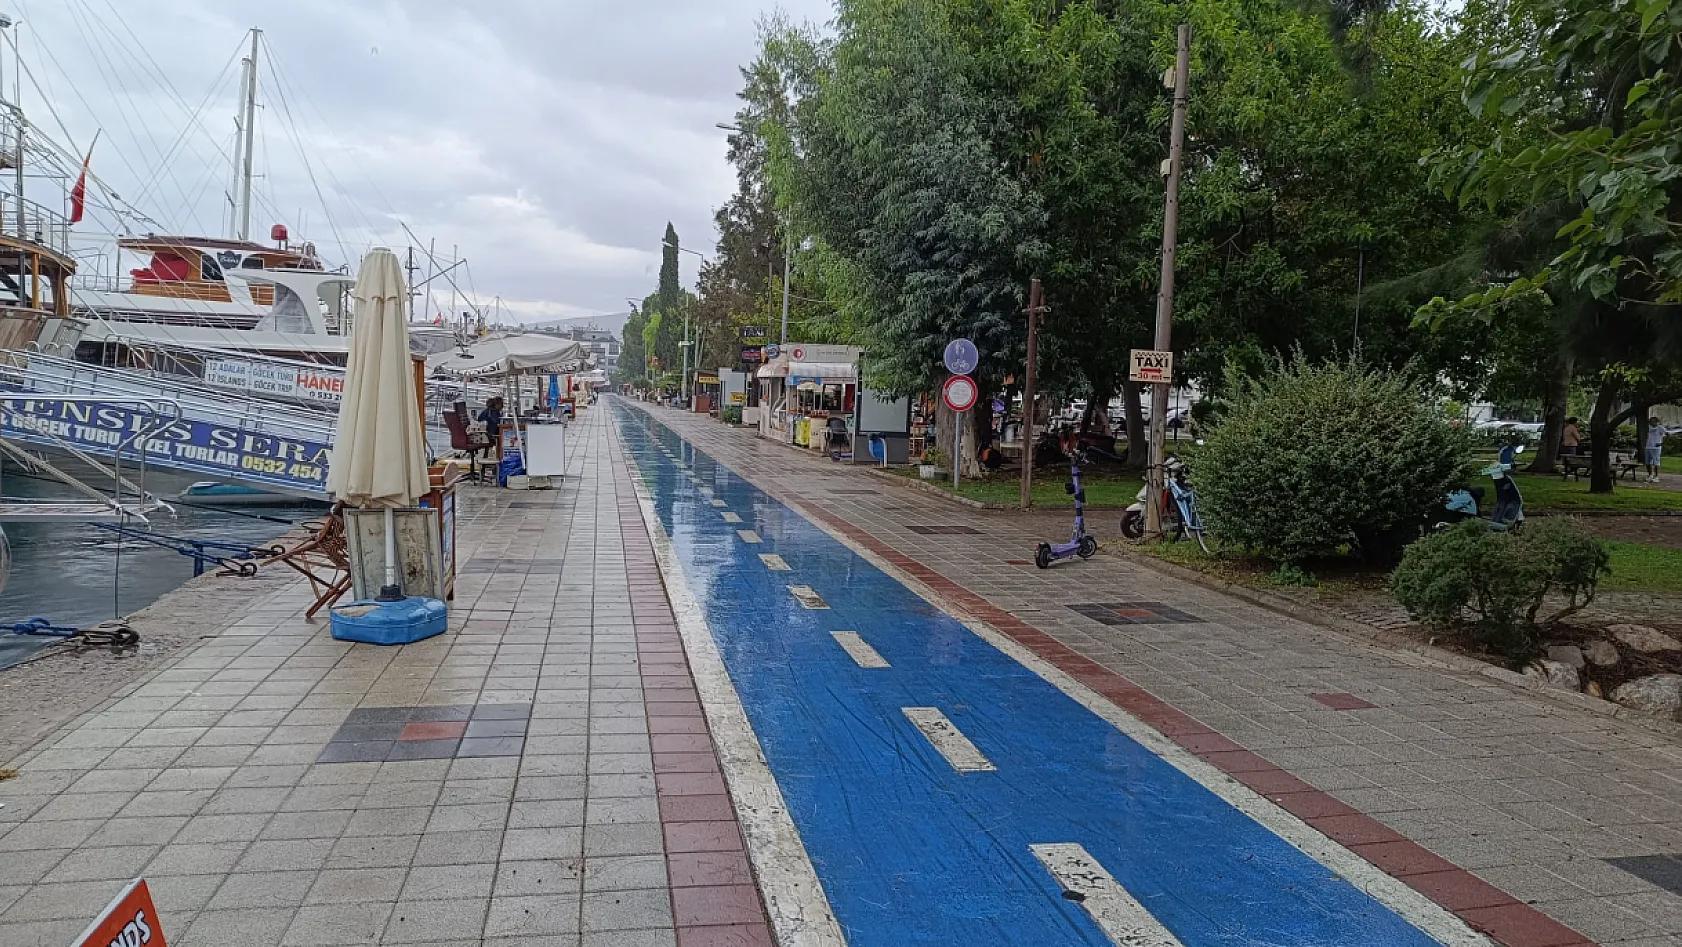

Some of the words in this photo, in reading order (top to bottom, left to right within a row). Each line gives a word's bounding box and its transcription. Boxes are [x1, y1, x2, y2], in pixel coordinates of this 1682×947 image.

[209, 362, 217, 371] 12
[219, 363, 246, 375] ADALAR
[1135, 357, 1168, 368] TAXI
[207, 373, 216, 383] 12
[216, 374, 247, 387] ISLANDS
[277, 383, 293, 393] TRIP
[317, 391, 333, 400] 533
[1, 399, 192, 441] ENSES
[11, 411, 71, 437] GÖCEK
[74, 424, 121, 446] TURU
[133, 434, 171, 456] ÖZEL
[175, 442, 239, 467] TURLAR
[241, 455, 286, 475] 0532
[289, 463, 322, 481] 454
